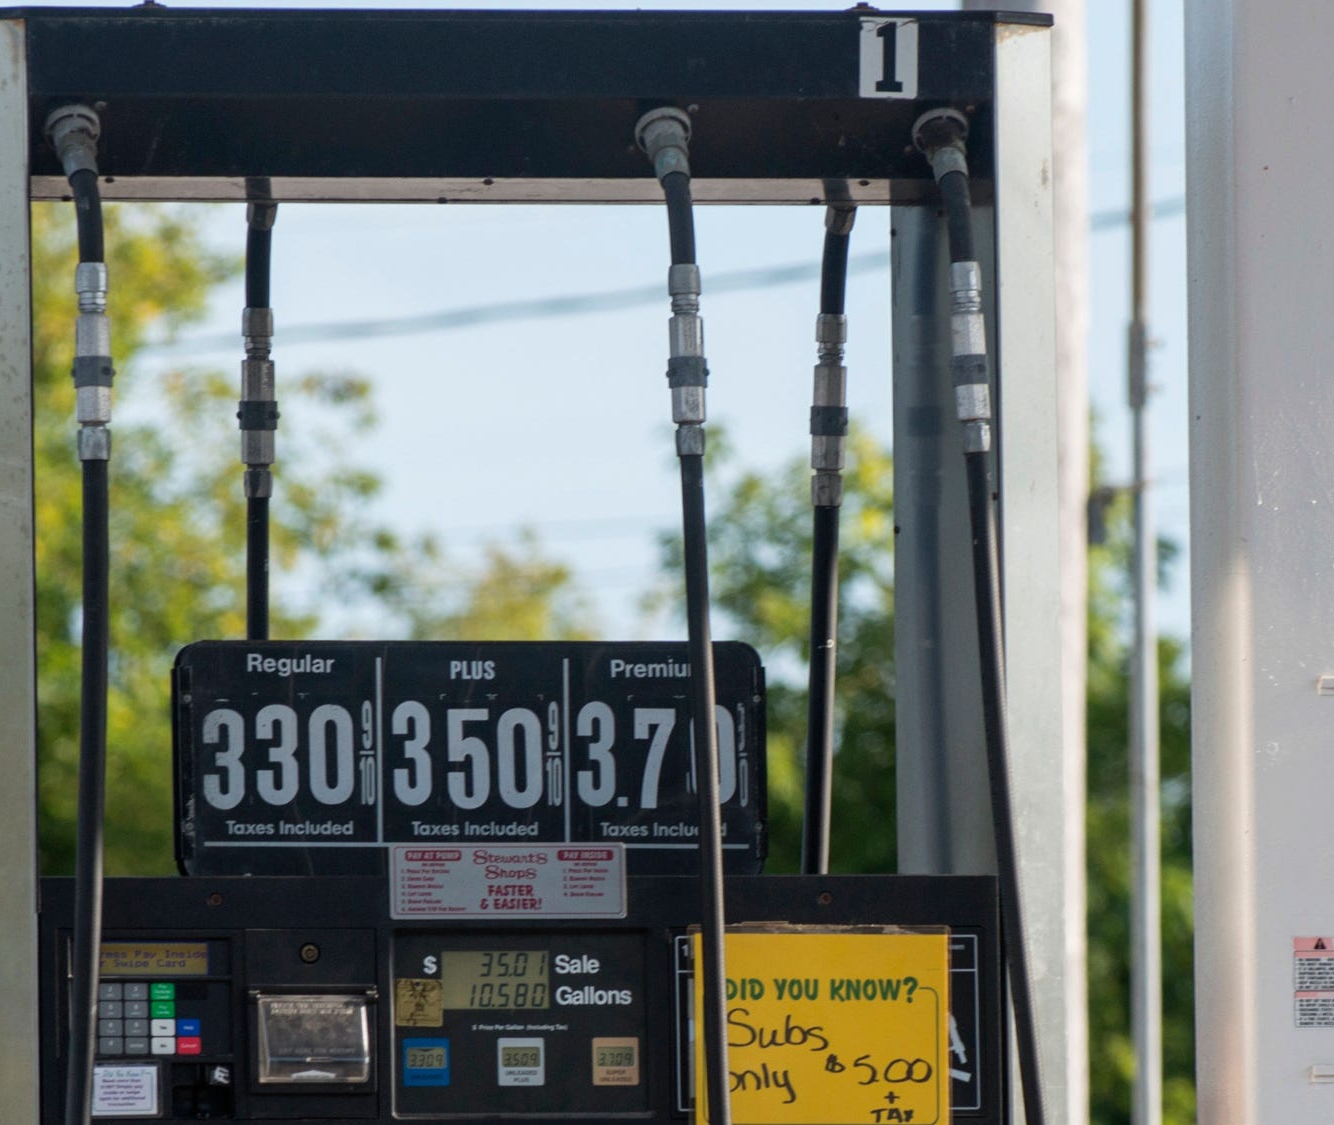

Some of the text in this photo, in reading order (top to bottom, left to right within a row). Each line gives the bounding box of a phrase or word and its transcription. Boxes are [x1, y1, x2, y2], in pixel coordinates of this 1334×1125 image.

[875, 21, 903, 93] 1
[246, 653, 335, 677] Regular
[450, 660, 495, 680] PLUS
[610, 658, 692, 678] Premiu
[226, 820, 354, 835] Taxes Included
[411, 821, 539, 836] Taxes Included
[600, 822, 649, 837] Taxes
[485, 865, 537, 880] Shops
[487, 885, 534, 896] FASTER
[480, 898, 489, 910] &
[494, 898, 543, 910] EASIER!
[156, 960, 186, 968] Card
[423, 953, 546, 977] $ 35.01
[555, 954, 600, 974] Sale
[470, 983, 547, 1009] 10.580
[555, 985, 633, 1006] Gallons
[726, 976, 919, 1003] DID YOU KNOW?
[727, 1008, 829, 1052] Subs
[871, 1107, 915, 1124] TAX
